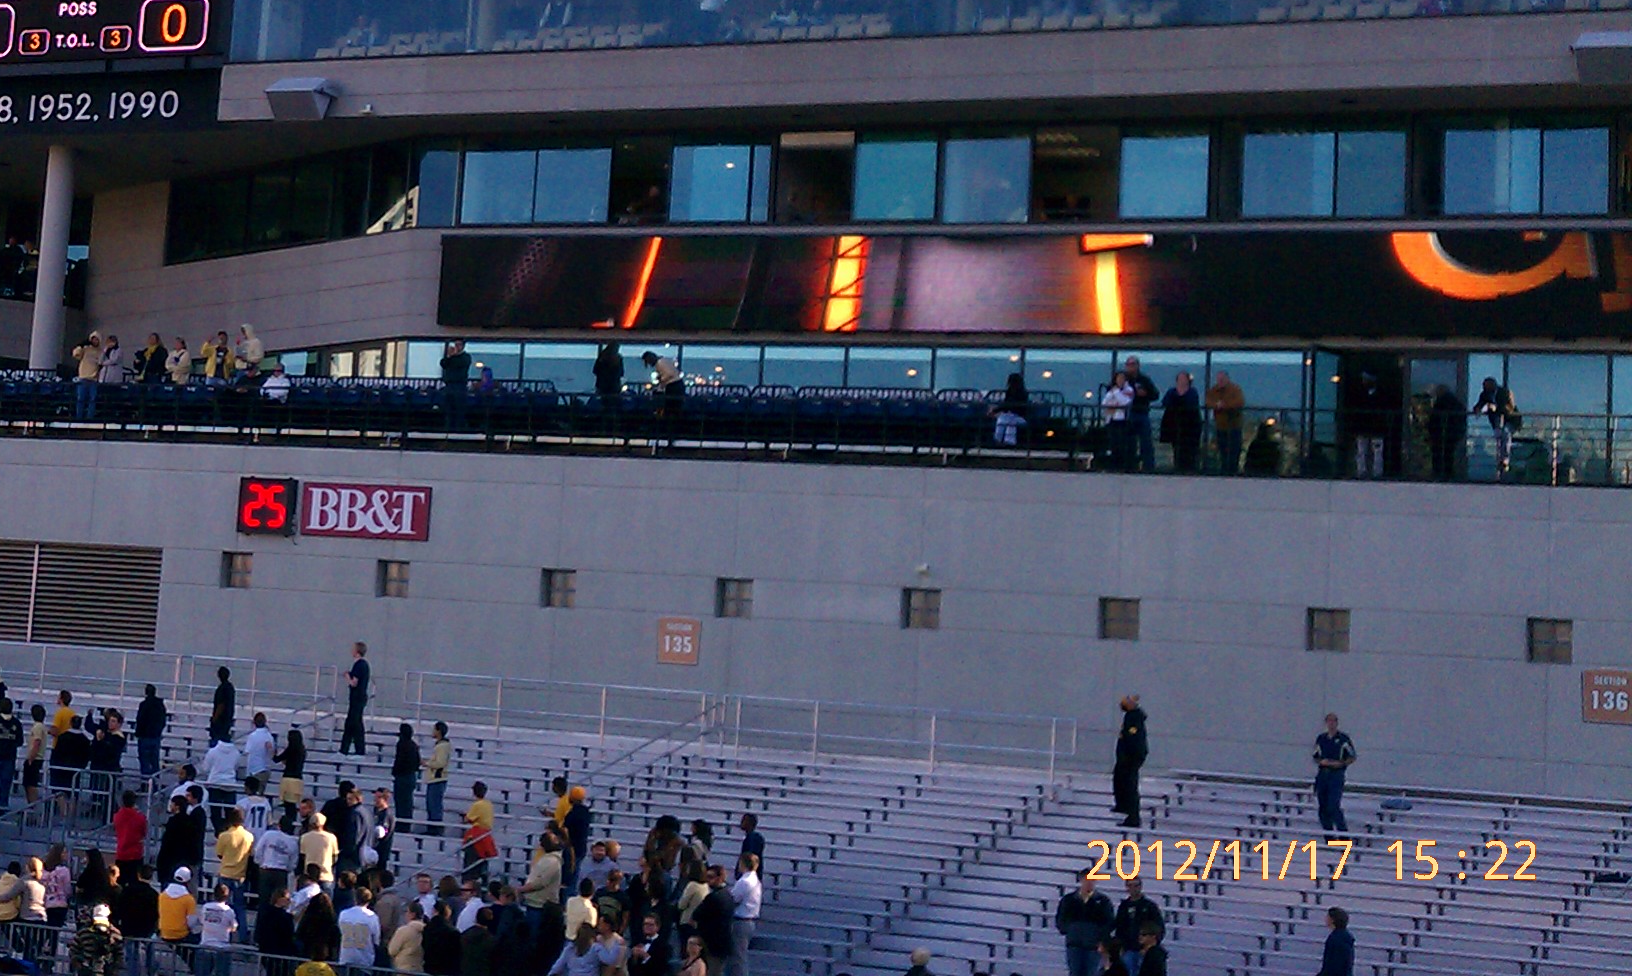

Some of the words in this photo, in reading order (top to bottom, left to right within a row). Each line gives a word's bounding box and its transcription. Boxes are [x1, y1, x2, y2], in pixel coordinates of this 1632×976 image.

[58, 0, 98, 17] POSS
[161, 3, 188, 43] 0
[29, 33, 41, 49] 3
[109, 29, 121, 46] 3
[28, 93, 99, 122] 1952,
[109, 90, 180, 119] 1990
[242, 483, 287, 528] 25
[305, 487, 426, 535] BB&T
[664, 635, 693, 653] 135
[1591, 689, 1629, 712] 136
[250, 805, 266, 829] 17
